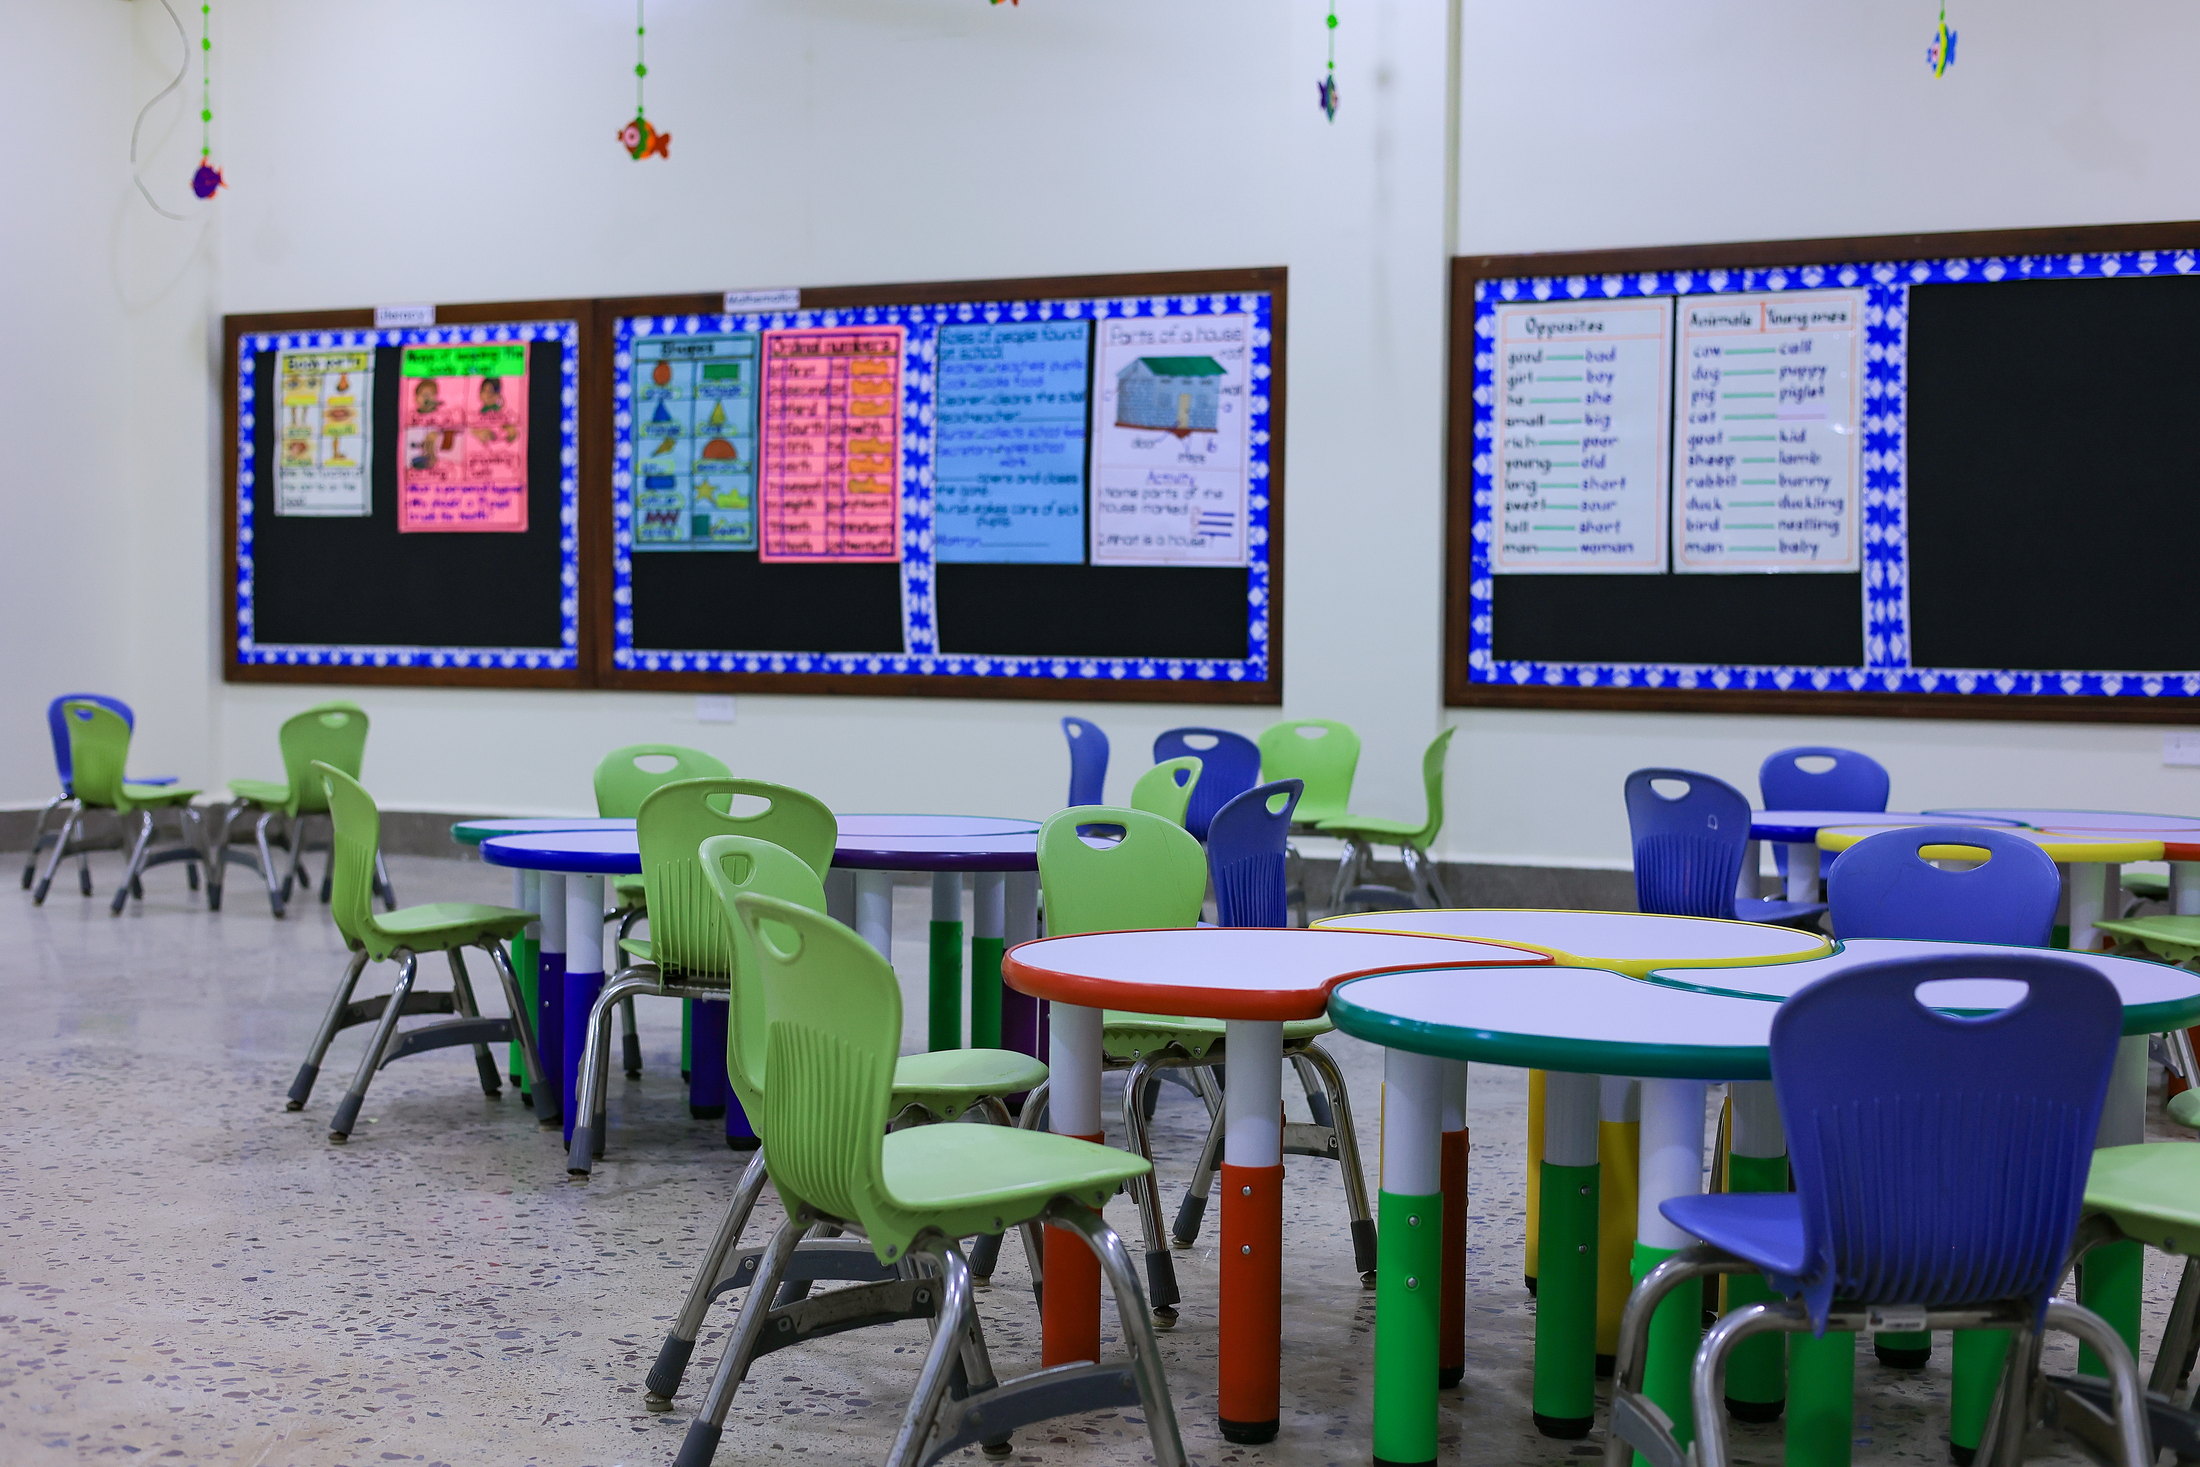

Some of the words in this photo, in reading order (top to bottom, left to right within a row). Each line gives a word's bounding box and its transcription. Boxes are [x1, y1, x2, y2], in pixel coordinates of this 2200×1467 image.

[1525, 316, 1606, 340] Opposites
[1690, 310, 1753, 328] Animals
[1111, 325, 1154, 345] Parts
[1159, 323, 1179, 344] of
[1181, 329, 1193, 343] a
[1196, 325, 1242, 342] house
[1507, 349, 1544, 369] good
[1585, 346, 1617, 363] bad
[1692, 345, 1722, 358] cow
[1506, 370, 1534, 390] girl
[1586, 368, 1615, 389] boy
[1692, 365, 1721, 388] dog
[1778, 364, 1828, 383] puppy
[1507, 393, 1524, 406] he
[1585, 391, 1612, 406] she
[1691, 387, 1716, 408] pig
[1778, 384, 1826, 406] piglet
[1504, 413, 1545, 428] small
[1585, 413, 1611, 432] big
[1688, 411, 1717, 424] cat
[1504, 434, 1537, 450] rich
[1582, 436, 1619, 454] poor
[1687, 430, 1724, 450] goat
[1778, 428, 1808, 444] kid
[1504, 457, 1552, 476] young
[1580, 454, 1606, 470] old
[1688, 453, 1737, 471] sheep
[1778, 449, 1823, 466] lamb
[1504, 478, 1538, 498] long
[1582, 476, 1627, 492] short
[1686, 473, 1738, 489] rabbit
[1778, 472, 1833, 494] bunny
[1504, 499, 1547, 513] sweet
[1580, 500, 1618, 513] sour
[1685, 495, 1723, 511] duck
[1777, 494, 1845, 516] duckling
[1579, 520, 1622, 534] short
[1685, 517, 1721, 533] bird
[1777, 517, 1842, 538] nestling
[1503, 542, 1539, 555] man
[1580, 542, 1635, 555] woman
[1684, 541, 1725, 554] man
[1778, 538, 1821, 561] baby
